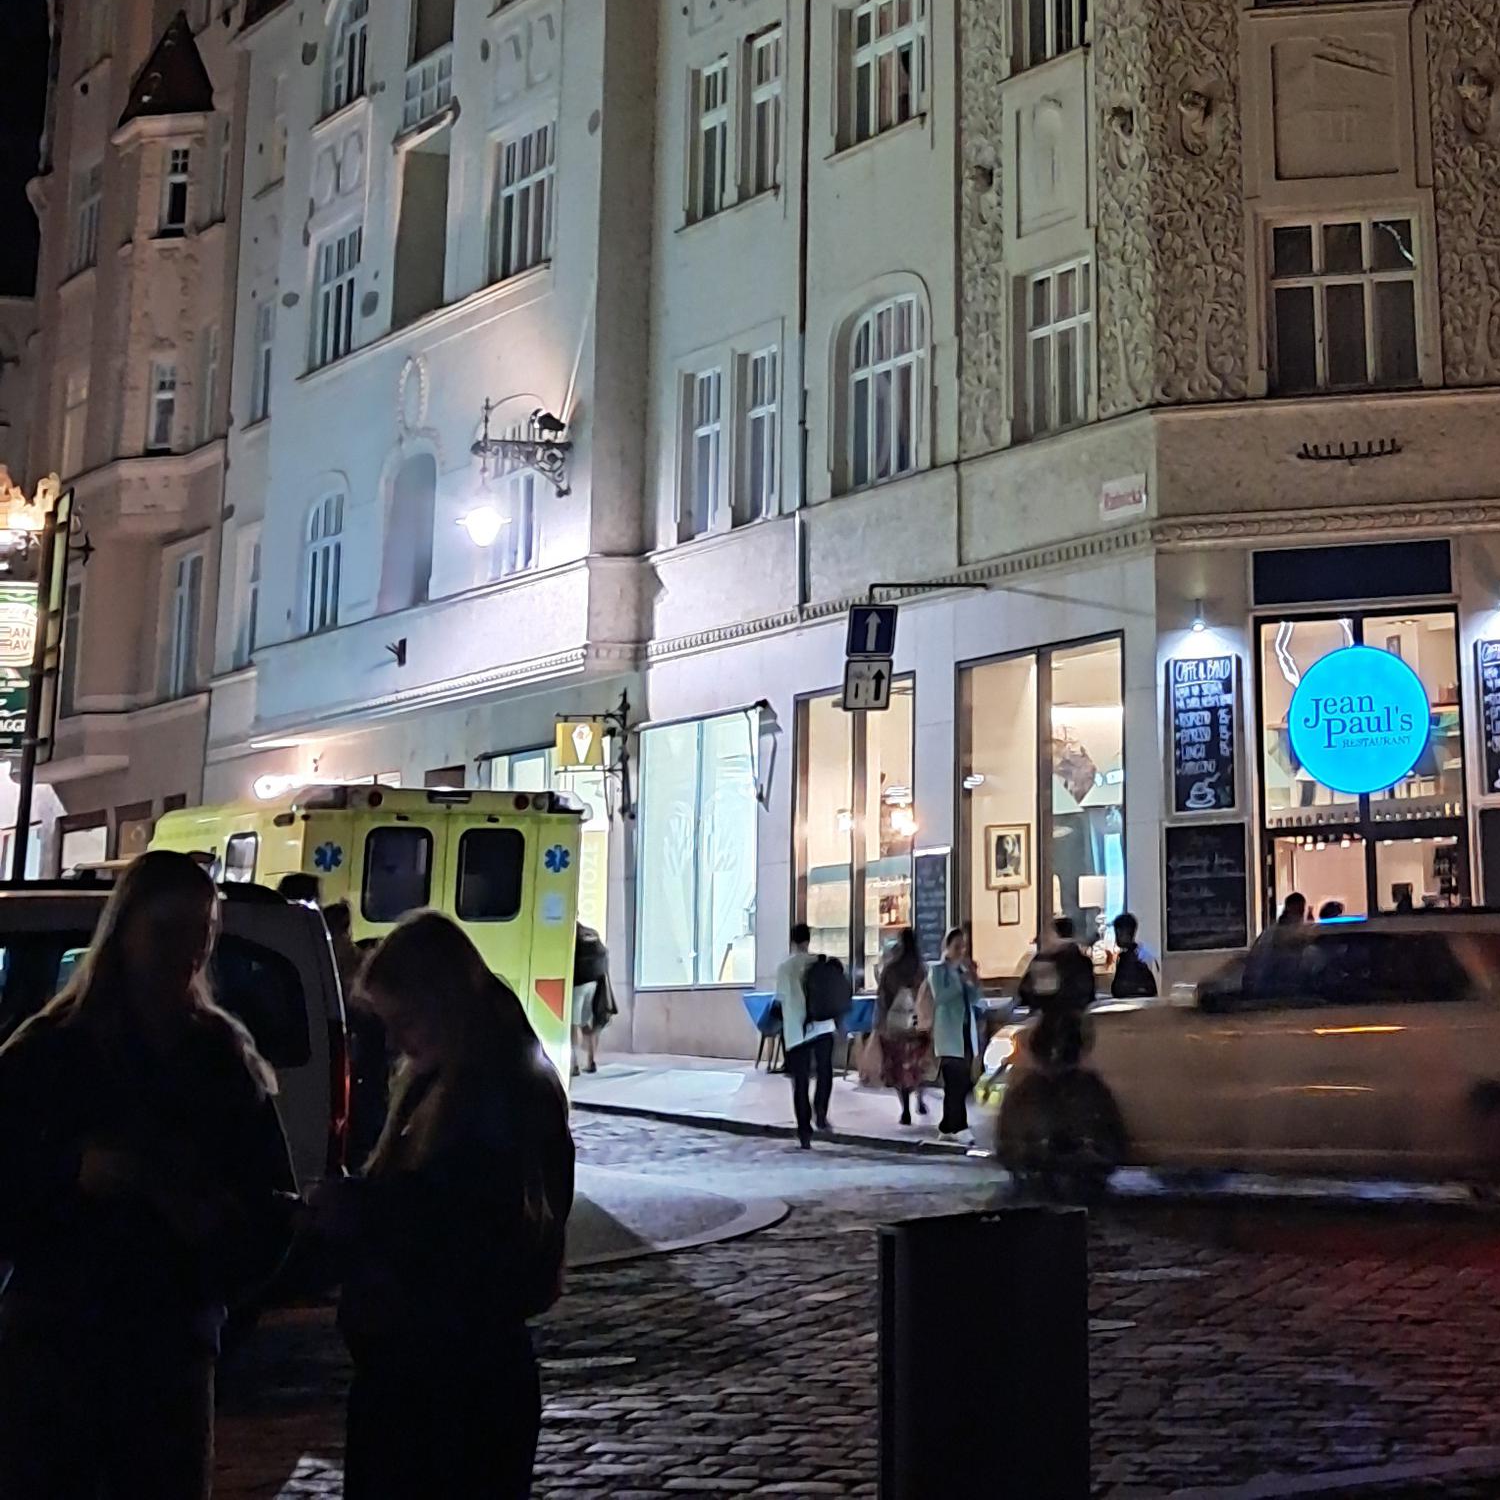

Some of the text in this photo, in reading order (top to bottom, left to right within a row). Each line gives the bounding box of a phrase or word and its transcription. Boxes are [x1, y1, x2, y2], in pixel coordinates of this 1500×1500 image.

[1303, 695, 1375, 729] Jean
[1322, 705, 1413, 749] Paul's
[1342, 736, 1411, 749] RESTAURANT
